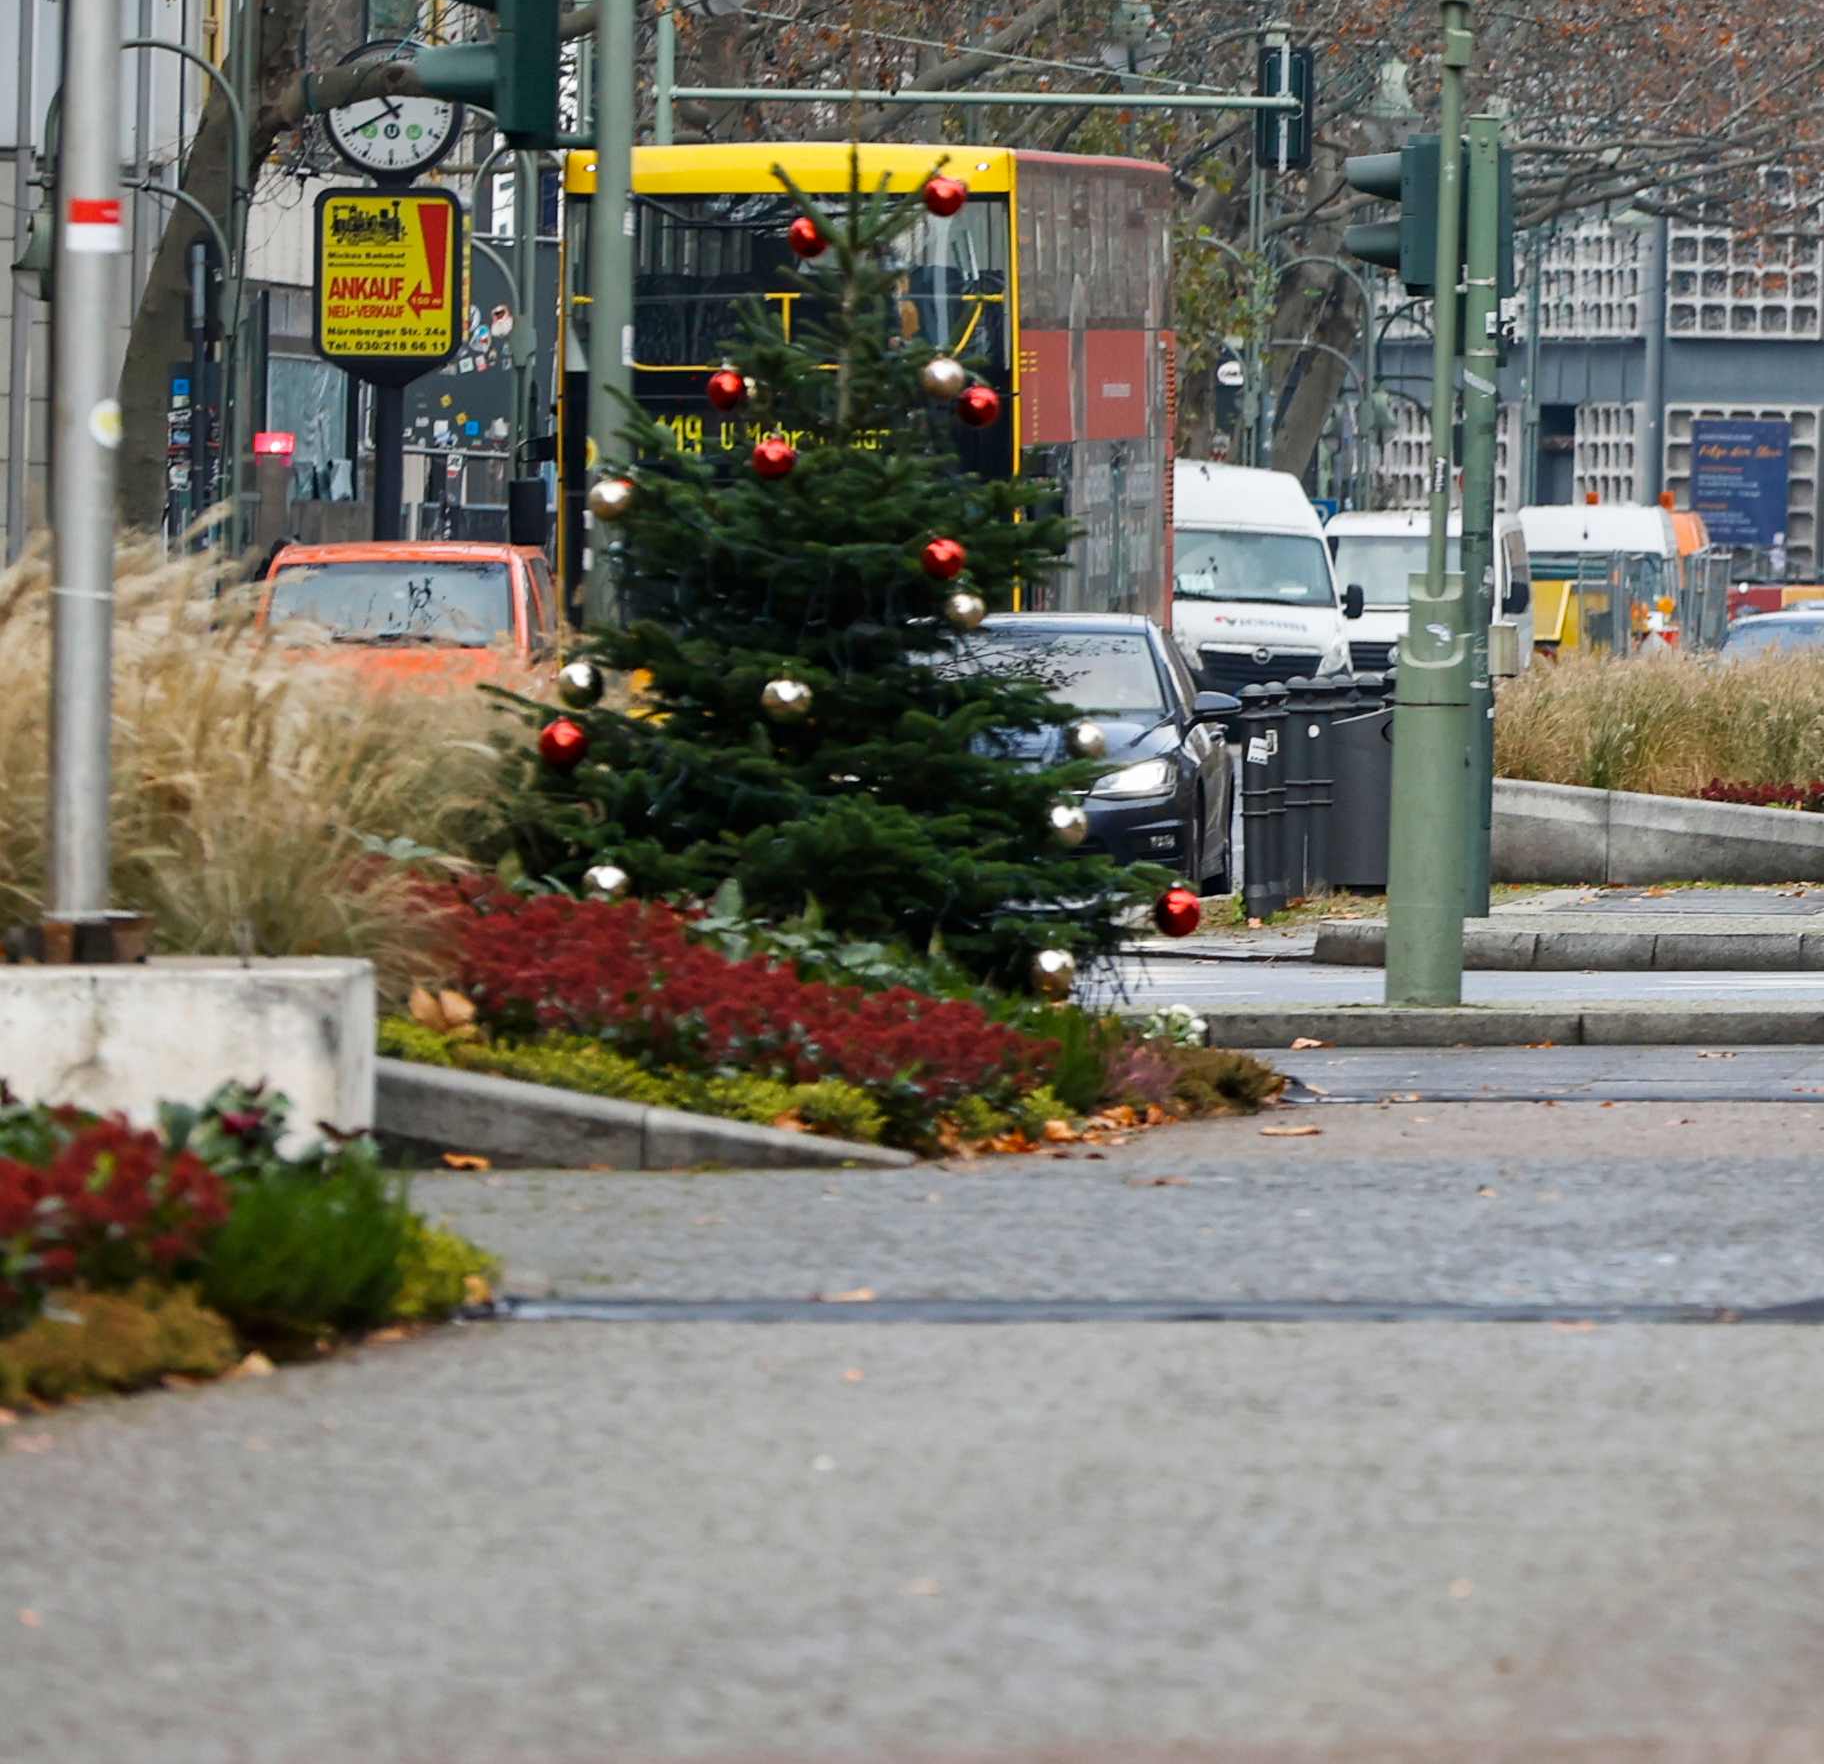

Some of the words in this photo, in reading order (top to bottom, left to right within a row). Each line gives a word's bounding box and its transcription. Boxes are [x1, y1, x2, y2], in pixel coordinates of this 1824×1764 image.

[328, 277, 404, 300] ANKAUF
[400, 326, 421, 336] Str.
[328, 341, 351, 351] Tel.
[431, 341, 445, 351] 11
[720, 421, 735, 451] U
